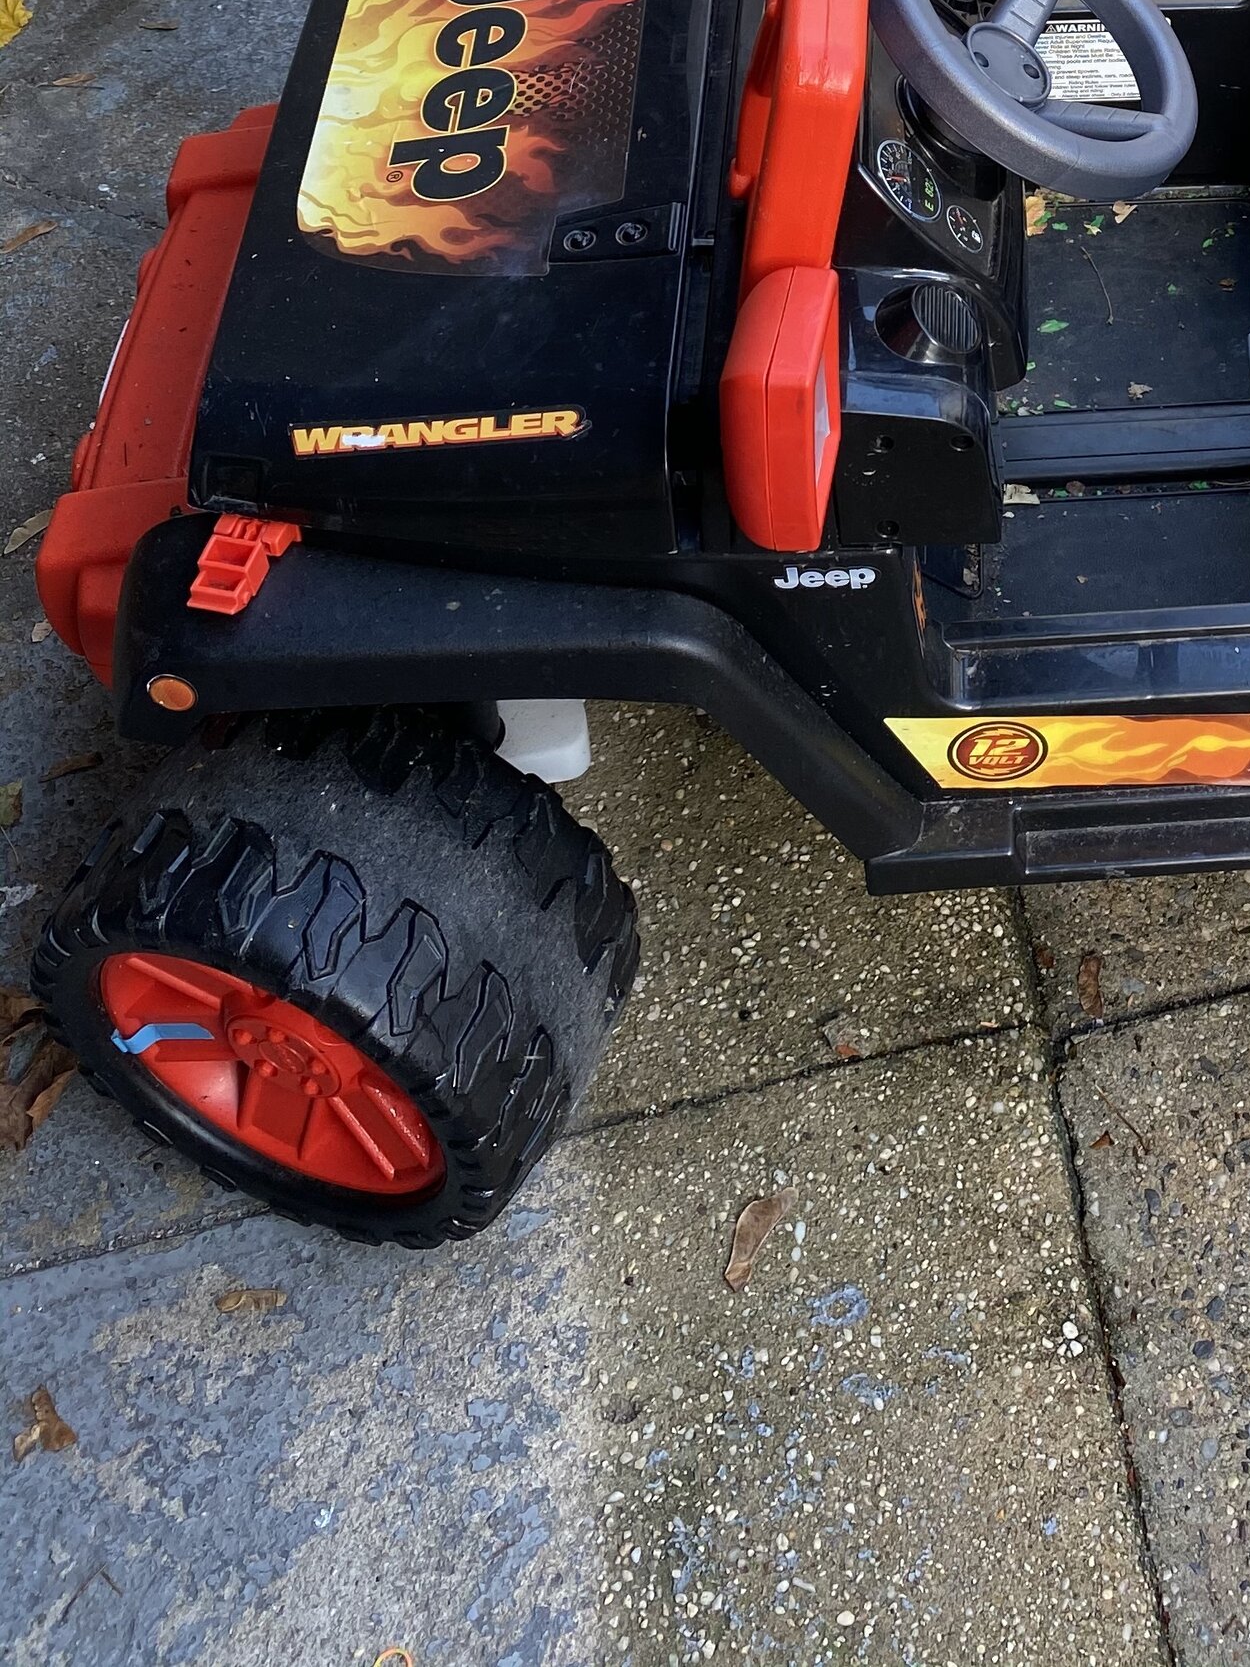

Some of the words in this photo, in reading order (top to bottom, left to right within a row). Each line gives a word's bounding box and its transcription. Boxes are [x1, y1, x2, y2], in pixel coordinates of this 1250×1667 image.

[292, 410, 580, 455] WRANGLER
[773, 566, 877, 590] Jeep
[969, 738, 1030, 756] 12
[968, 755, 1029, 766] VOLT
